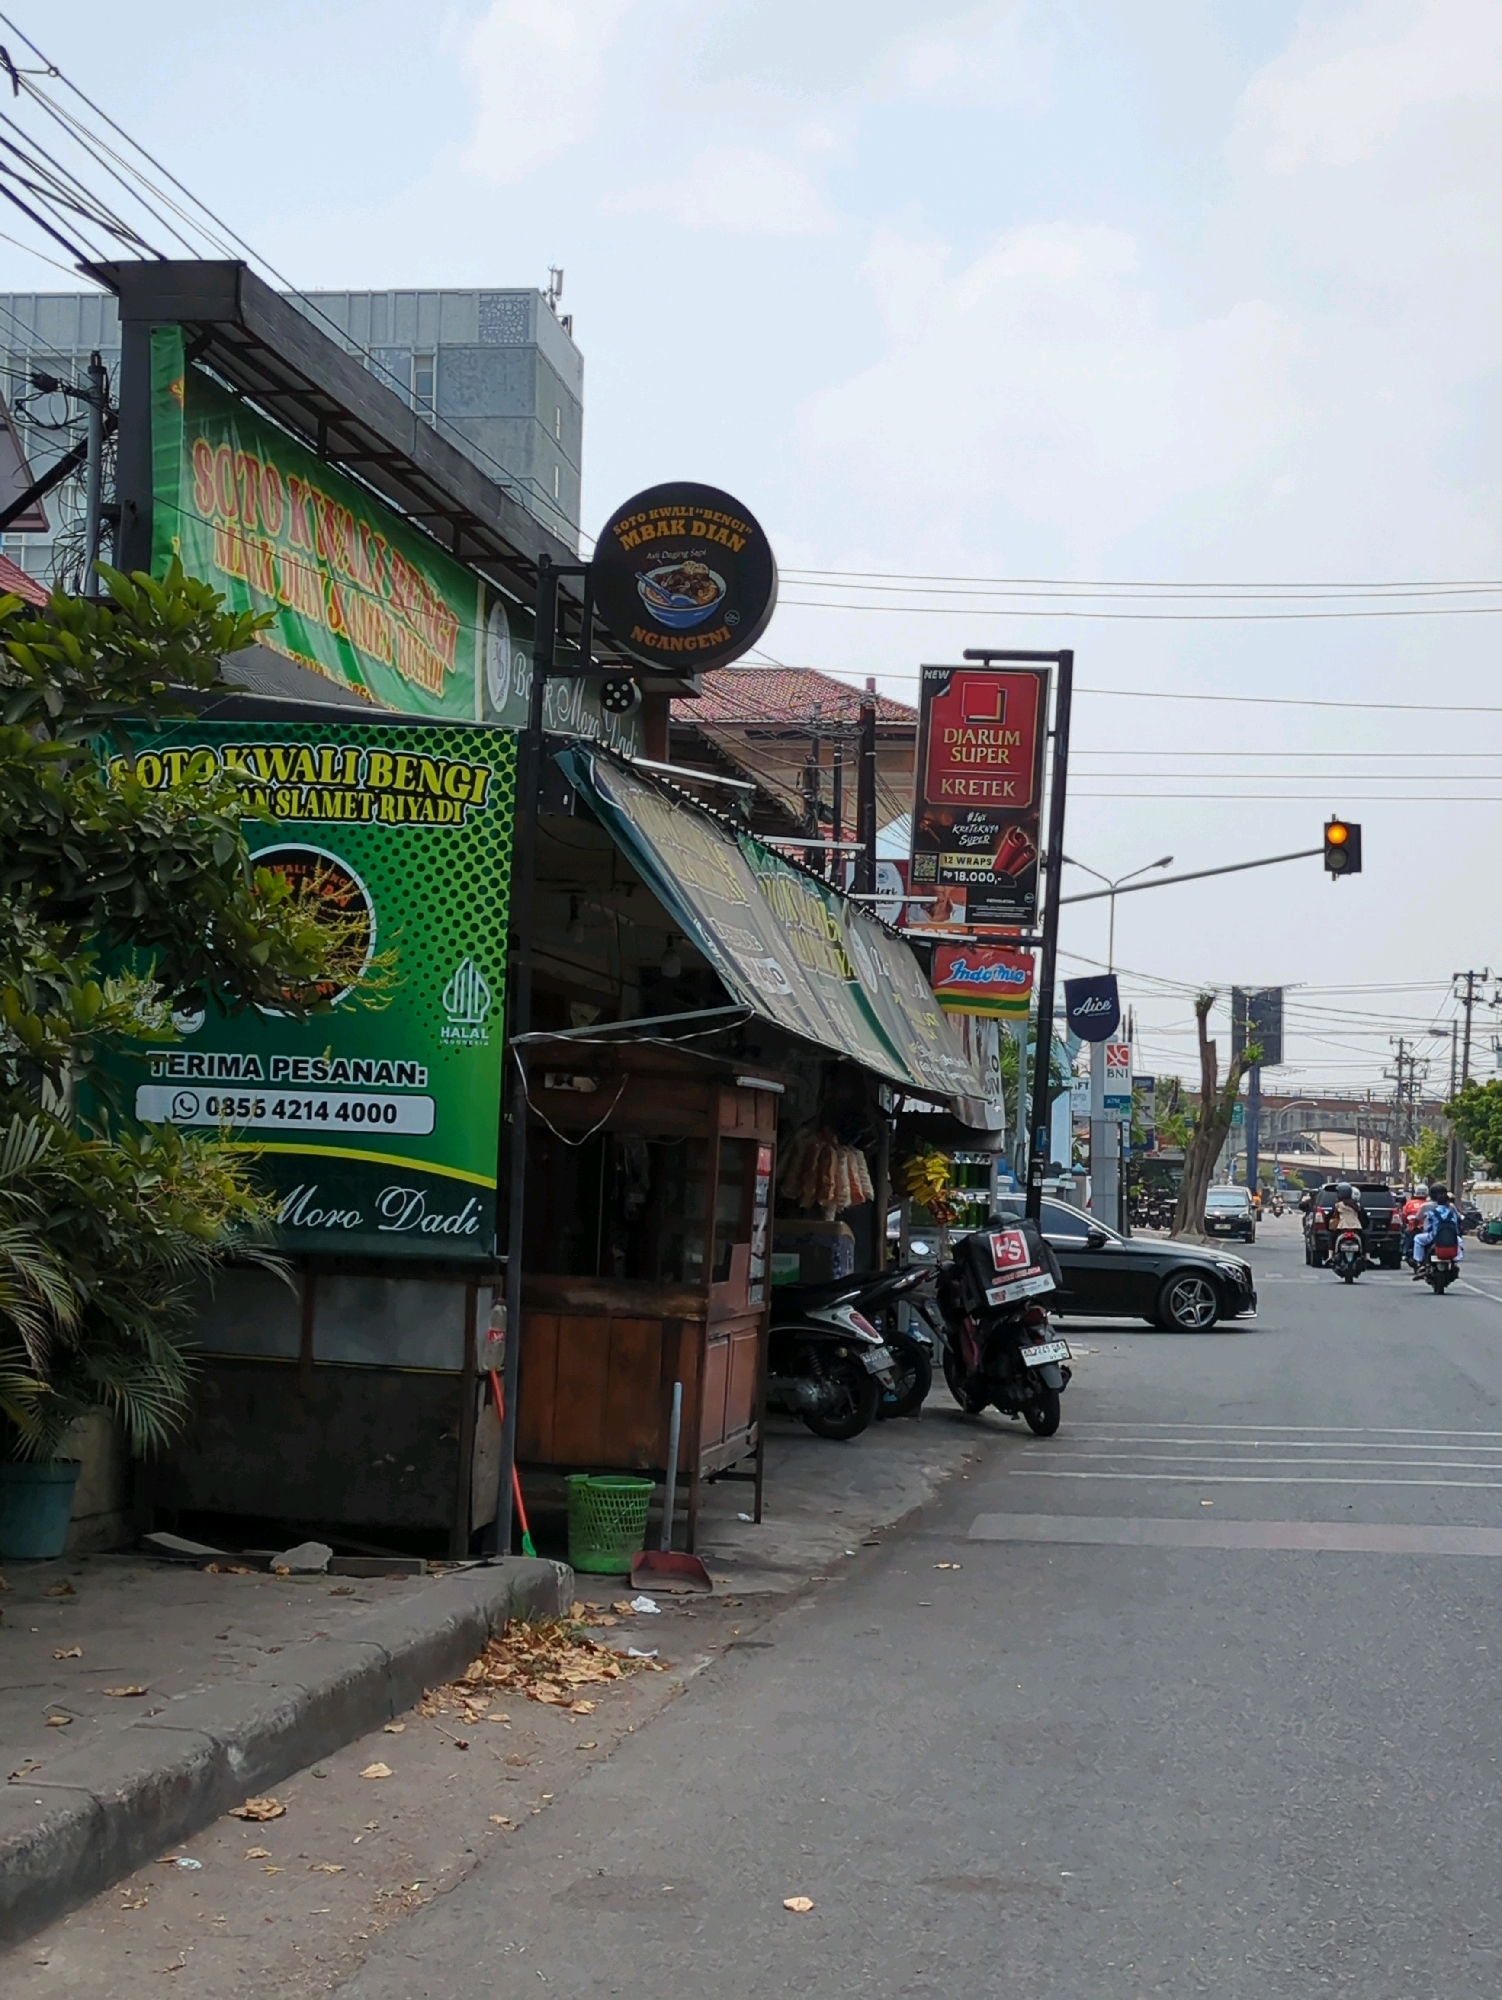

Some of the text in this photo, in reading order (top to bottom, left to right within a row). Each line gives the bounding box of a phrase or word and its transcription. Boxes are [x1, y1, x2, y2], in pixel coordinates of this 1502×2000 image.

[192, 437, 283, 537] SOTO
[613, 513, 646, 535] SOTO
[649, 506, 694, 520] KWALI
[619, 519, 746, 553] MBAK DIAN
[631, 625, 732, 651] NGANGENI
[924, 670, 950, 679] NEW
[943, 727, 1021, 747] DJARUM
[950, 746, 1010, 764] SUPER
[225, 748, 360, 785] KWALI
[369, 752, 490, 804] BENGI
[941, 778, 1015, 797] KRETEK
[276, 789, 374, 819] SLAMET
[378, 795, 465, 823] RIYADI
[943, 855, 993, 866] 12 WRAPS
[938, 958, 1026, 985] Indomie
[1072, 998, 1112, 1016] Aice
[441, 1027, 490, 1039] HALAL
[152, 1054, 427, 1085] TERIMA PESANAN:
[1107, 1069, 1129, 1079] BNI
[205, 1096, 397, 1124] 0856 4214 4000
[277, 1184, 484, 1235] Moro Dadi
